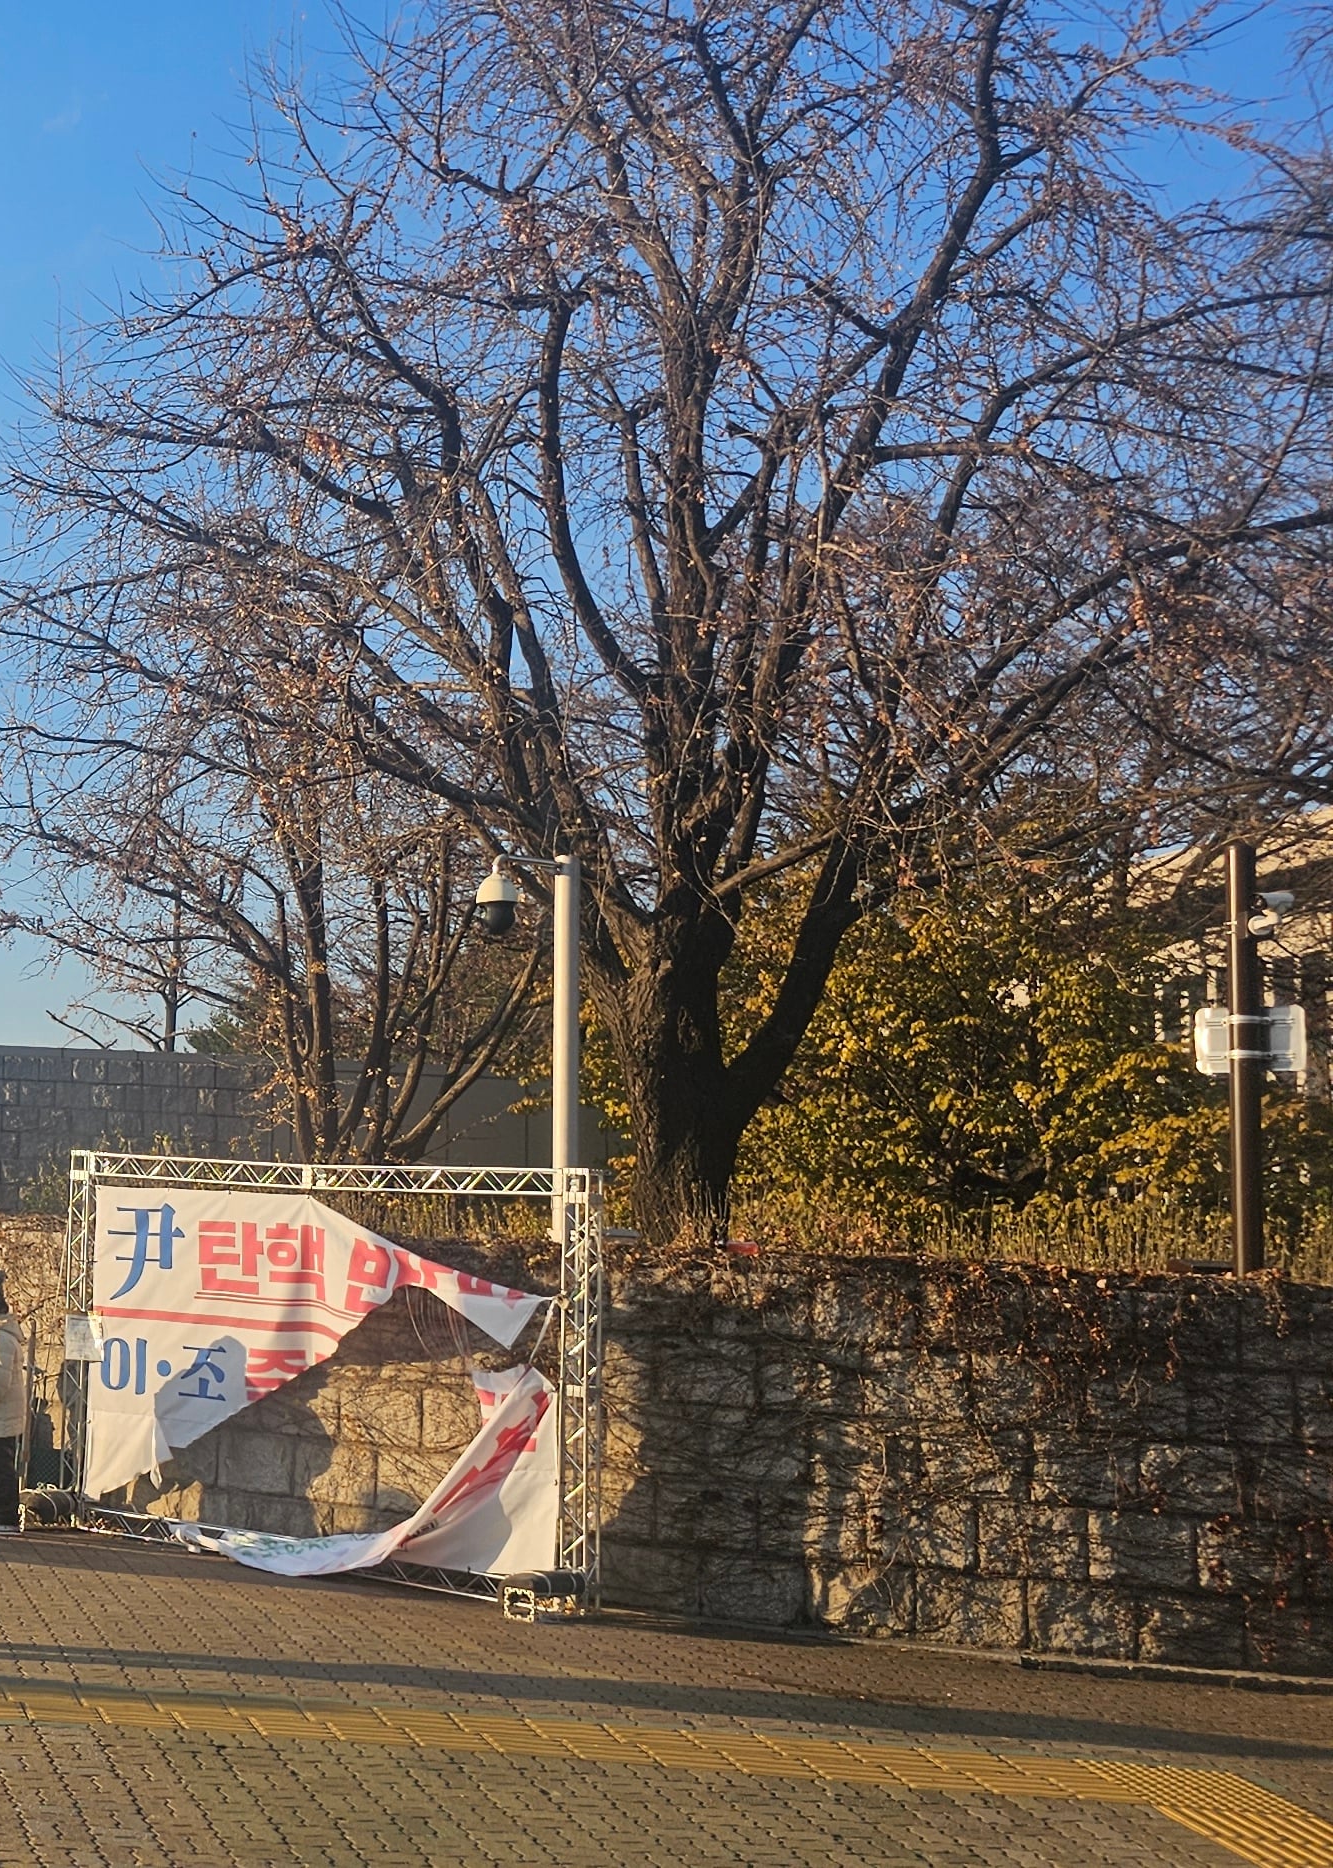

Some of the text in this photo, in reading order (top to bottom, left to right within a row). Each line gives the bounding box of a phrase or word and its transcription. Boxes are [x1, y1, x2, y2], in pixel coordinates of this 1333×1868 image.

[107, 1203, 185, 1300] 尹
[198, 1220, 326, 1302] 탄핵
[100, 1337, 227, 1402] 이·조
